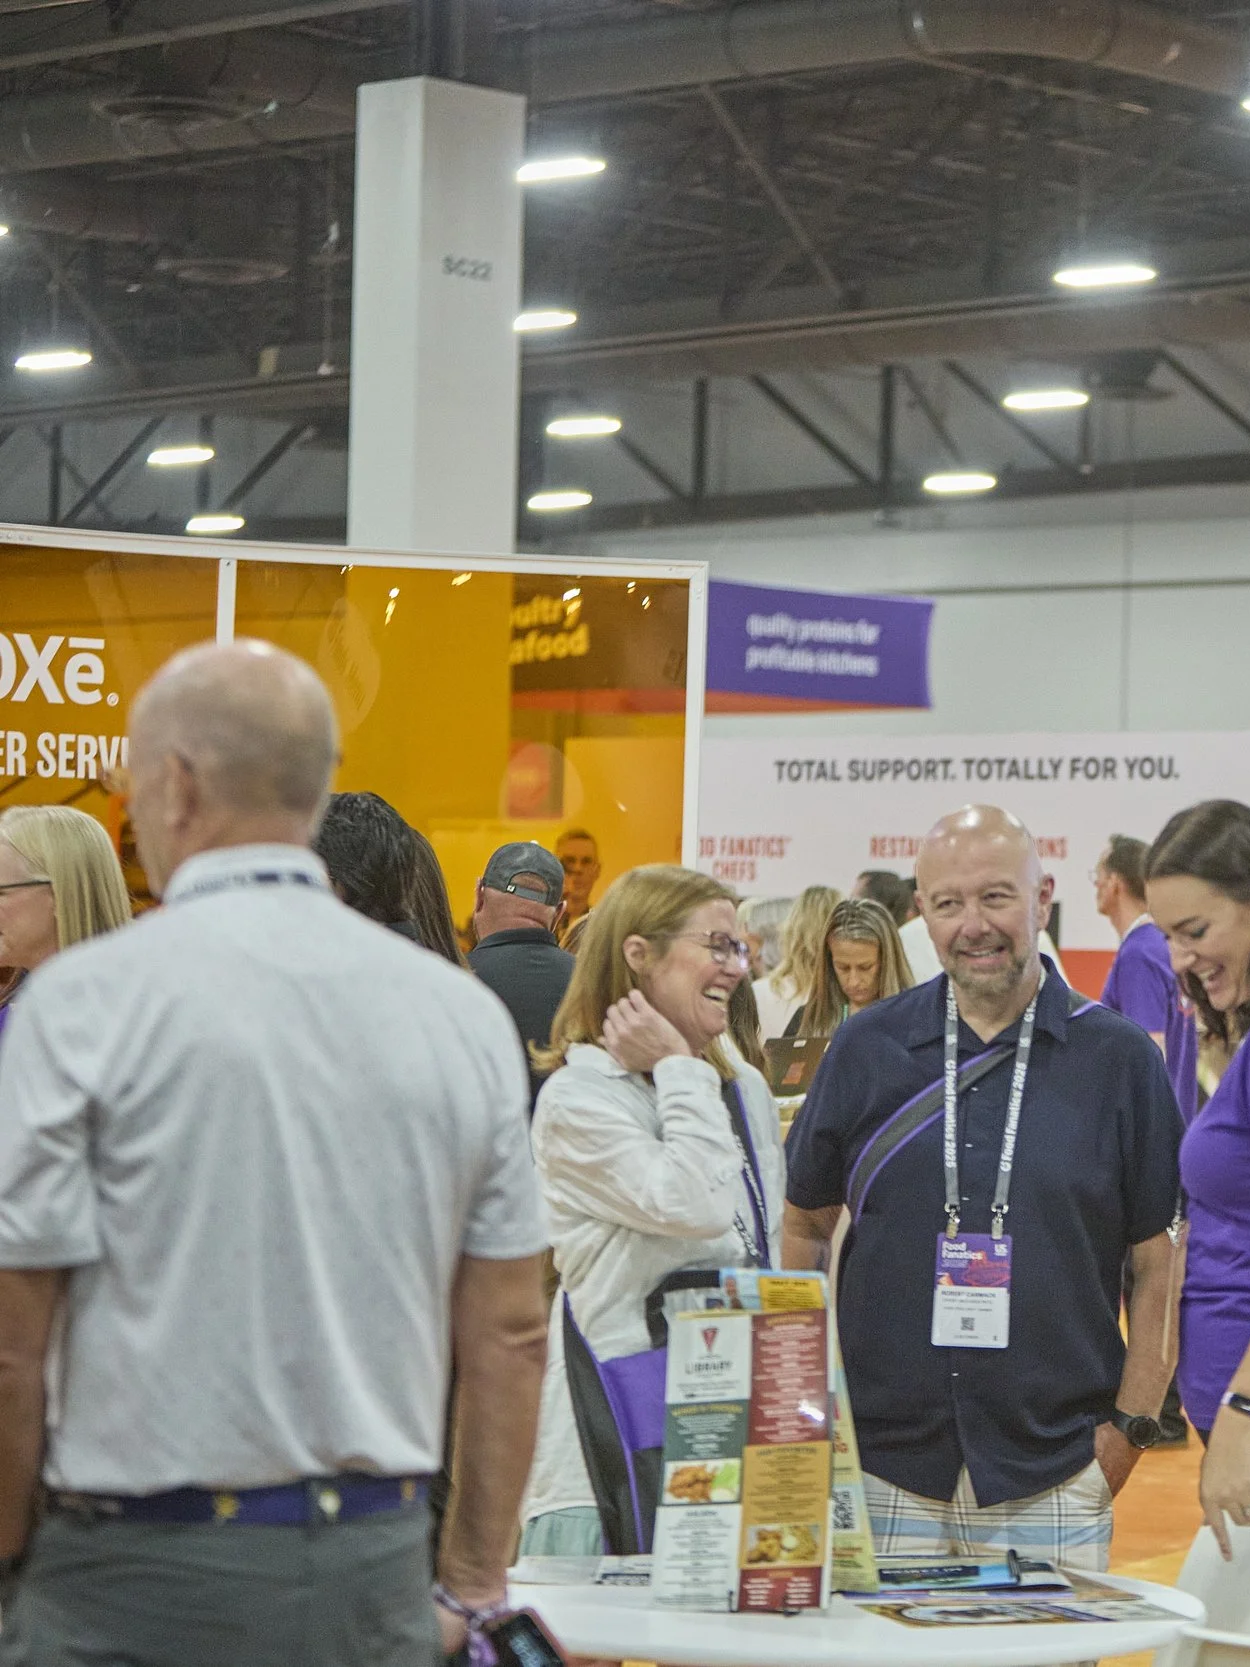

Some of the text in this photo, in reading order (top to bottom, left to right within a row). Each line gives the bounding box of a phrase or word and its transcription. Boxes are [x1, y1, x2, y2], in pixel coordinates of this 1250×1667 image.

[774, 756, 1181, 783] TOTAL SUPPORT. TOTALLY FOR YOU.
[942, 1241, 967, 1251] Food
[942, 1250, 983, 1260] Fanatics
